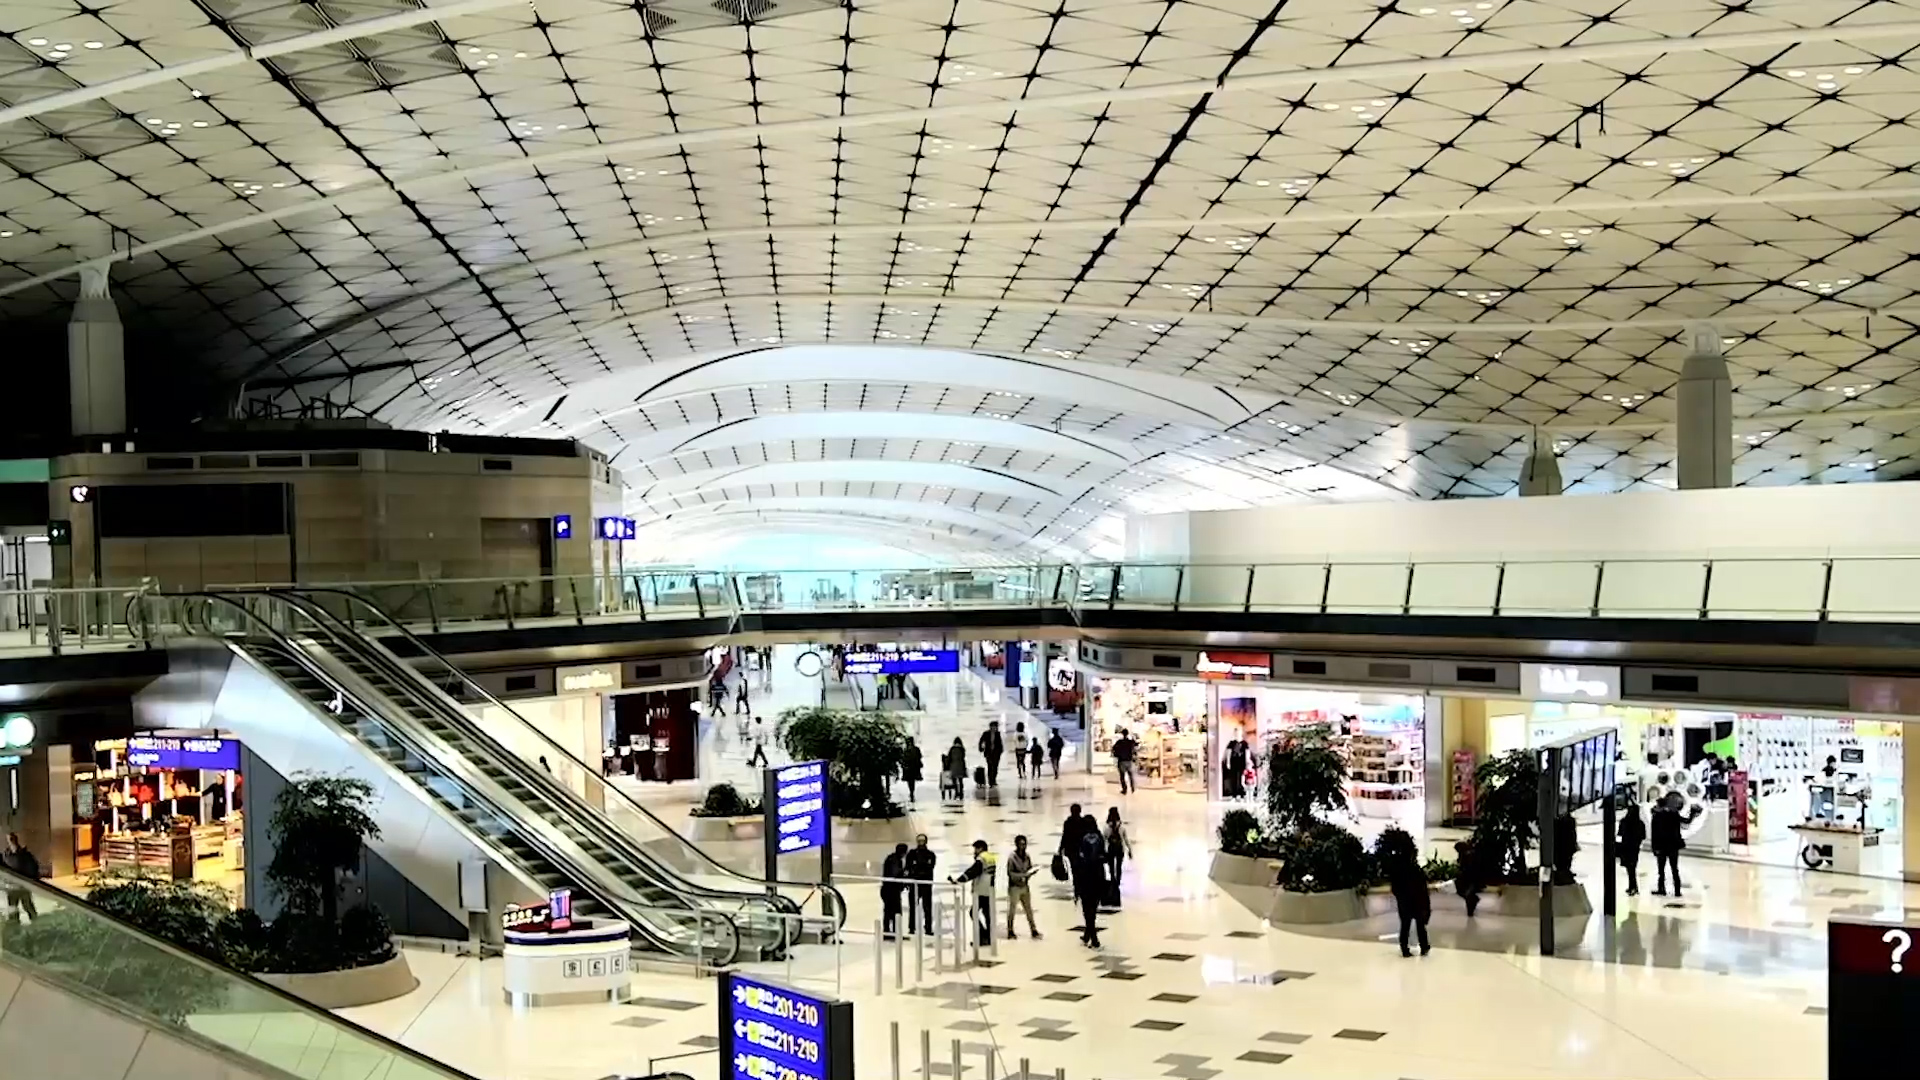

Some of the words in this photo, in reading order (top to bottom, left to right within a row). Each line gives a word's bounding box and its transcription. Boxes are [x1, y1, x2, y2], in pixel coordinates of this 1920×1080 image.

[1882, 929, 1912, 974] ?
[773, 994, 818, 1028] 201-210
[774, 1029, 818, 1064] 211-219
